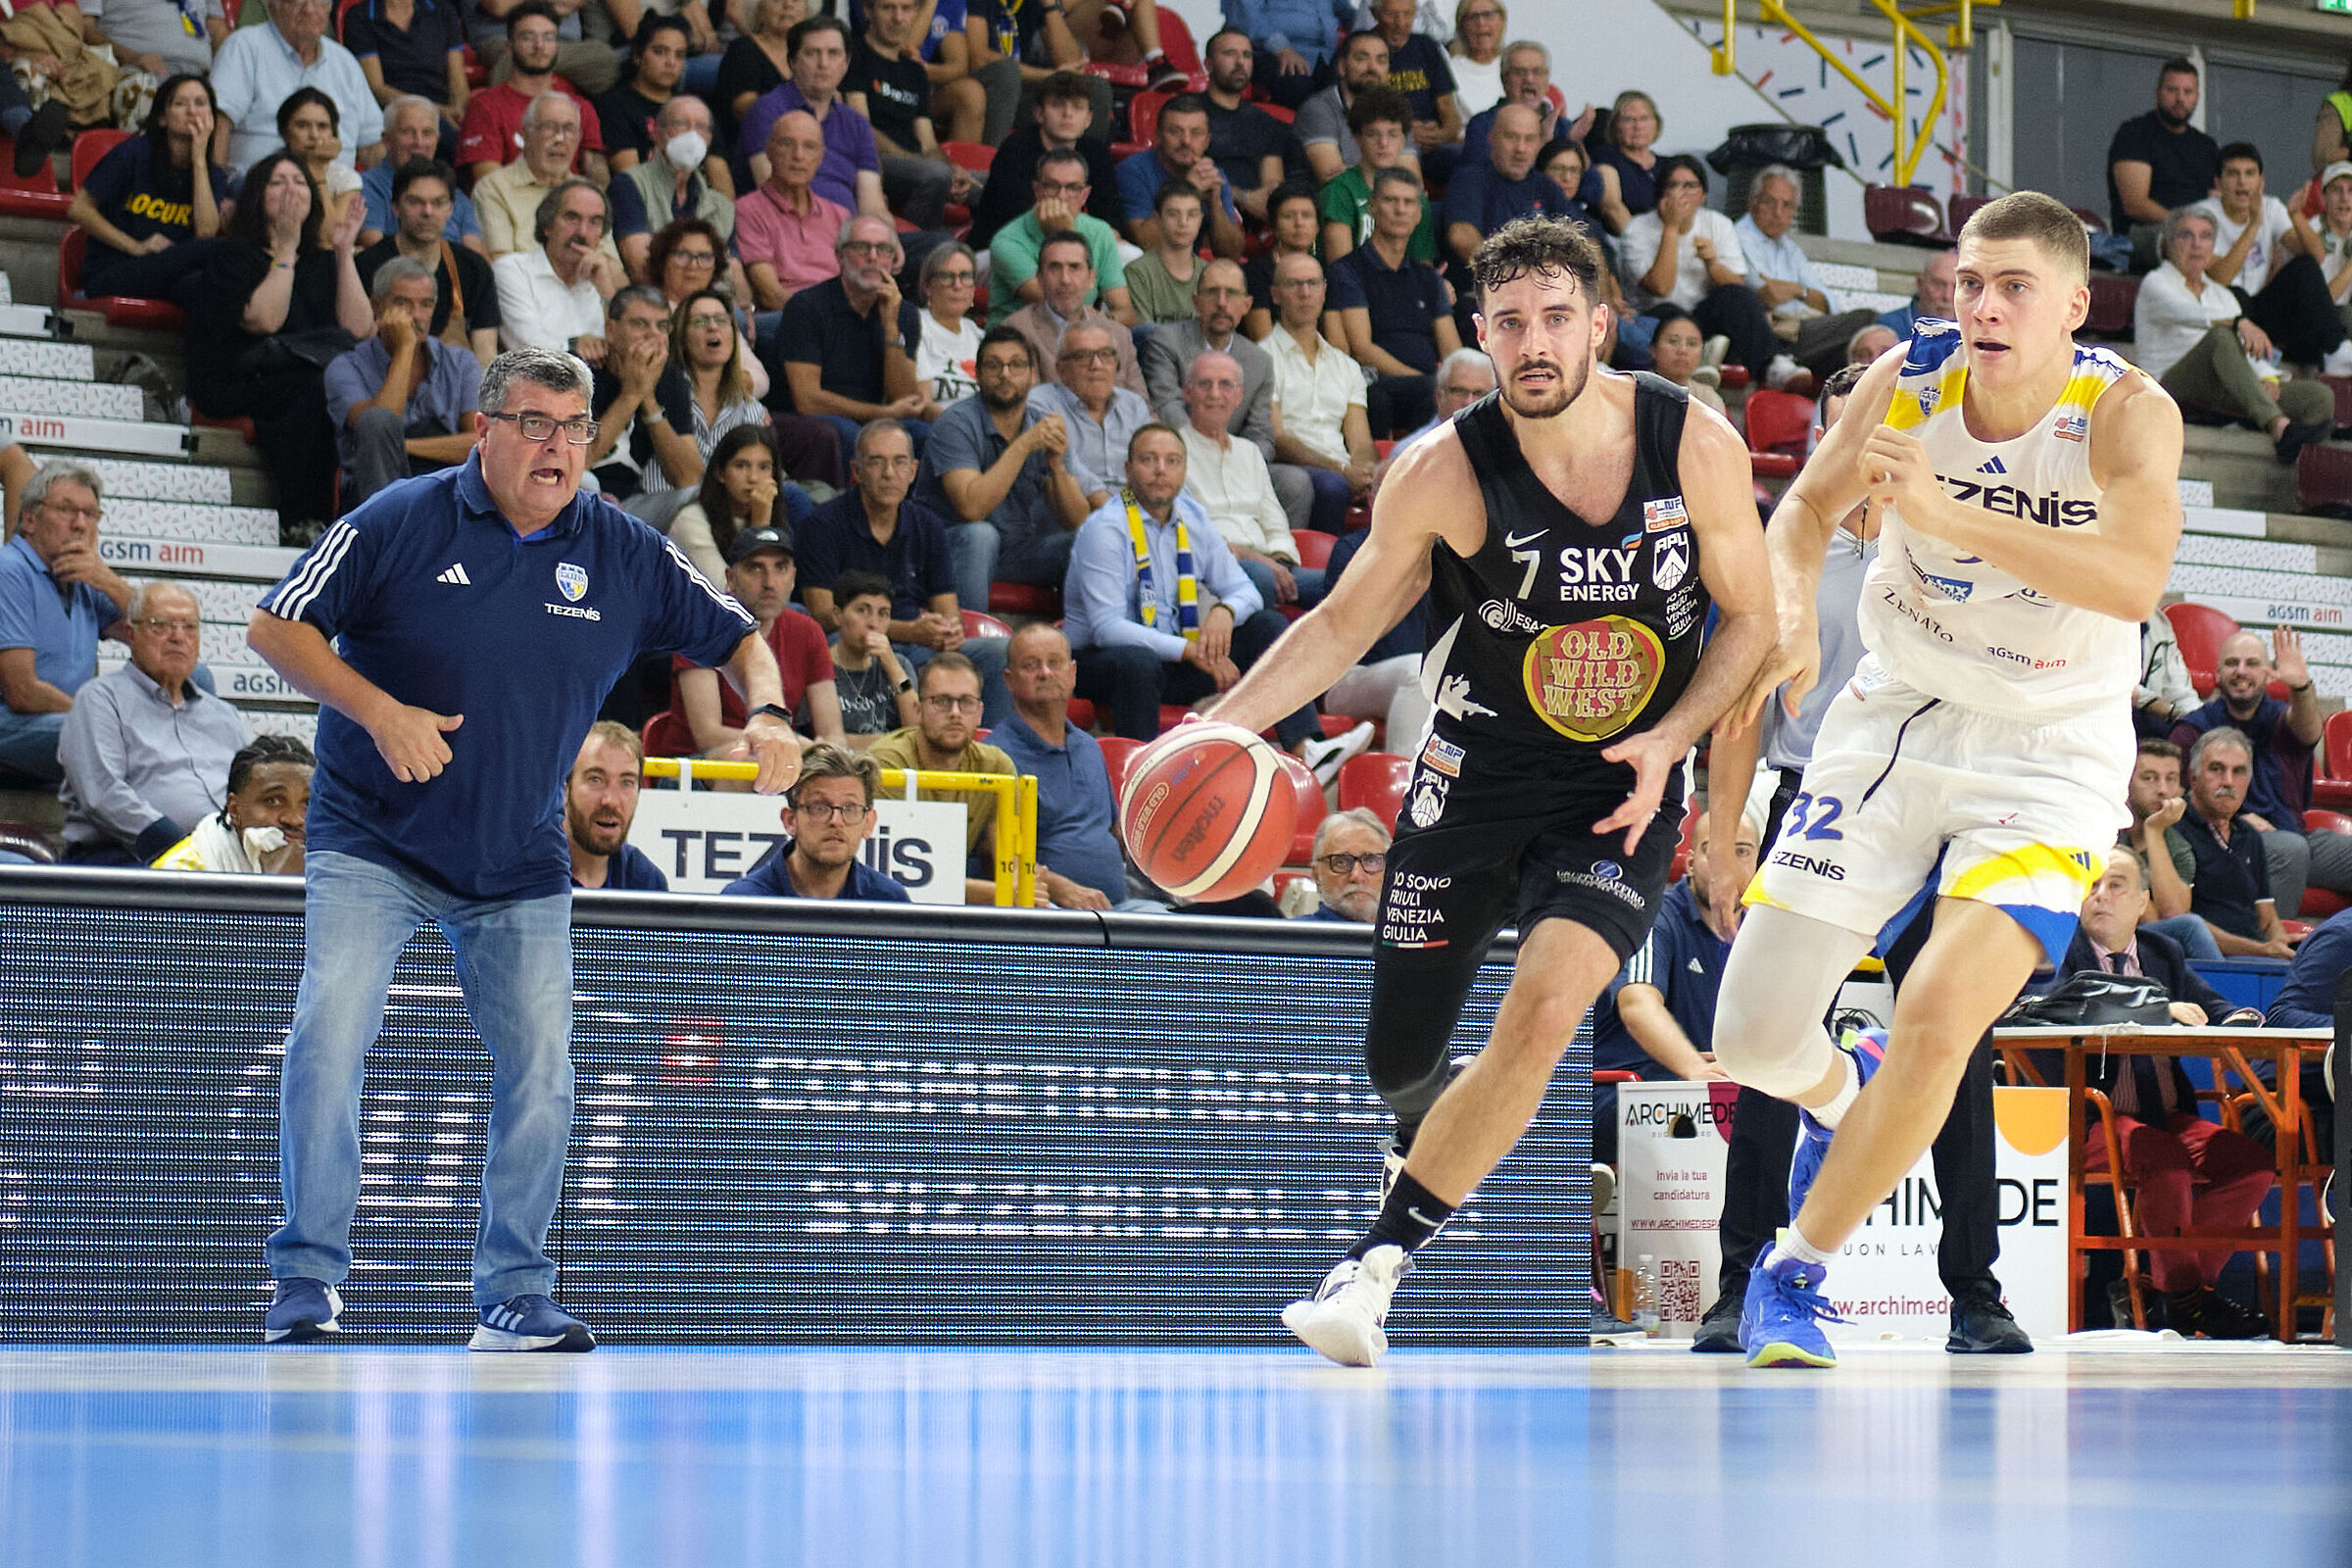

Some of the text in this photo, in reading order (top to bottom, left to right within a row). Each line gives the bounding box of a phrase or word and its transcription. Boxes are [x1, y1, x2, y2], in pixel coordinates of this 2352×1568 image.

[159, 543, 204, 564] aim
[1511, 549, 1541, 601] 7
[1560, 547, 1638, 583] SKY
[1560, 583, 1640, 602] ENERGY
[1883, 587, 1953, 643] ZENATO
[2313, 607, 2343, 623] aim
[1560, 630, 1634, 661] OLD
[1550, 658, 1641, 688] WILD
[1543, 685, 1642, 717] WEST
[1438, 741, 1463, 759] LNP
[1787, 791, 1843, 841] 32
[1171, 796, 1225, 862] molten
[1394, 871, 1451, 891] IO SONO
[1390, 889, 1421, 906] FRIULI
[1387, 906, 1445, 923] VENEZIA
[1383, 924, 1428, 941] GIULIA
[1656, 1169, 1708, 1182] Invia la tua
[1653, 1189, 1710, 1200] candidatura
[1843, 1244, 1939, 1256] UON LAV
